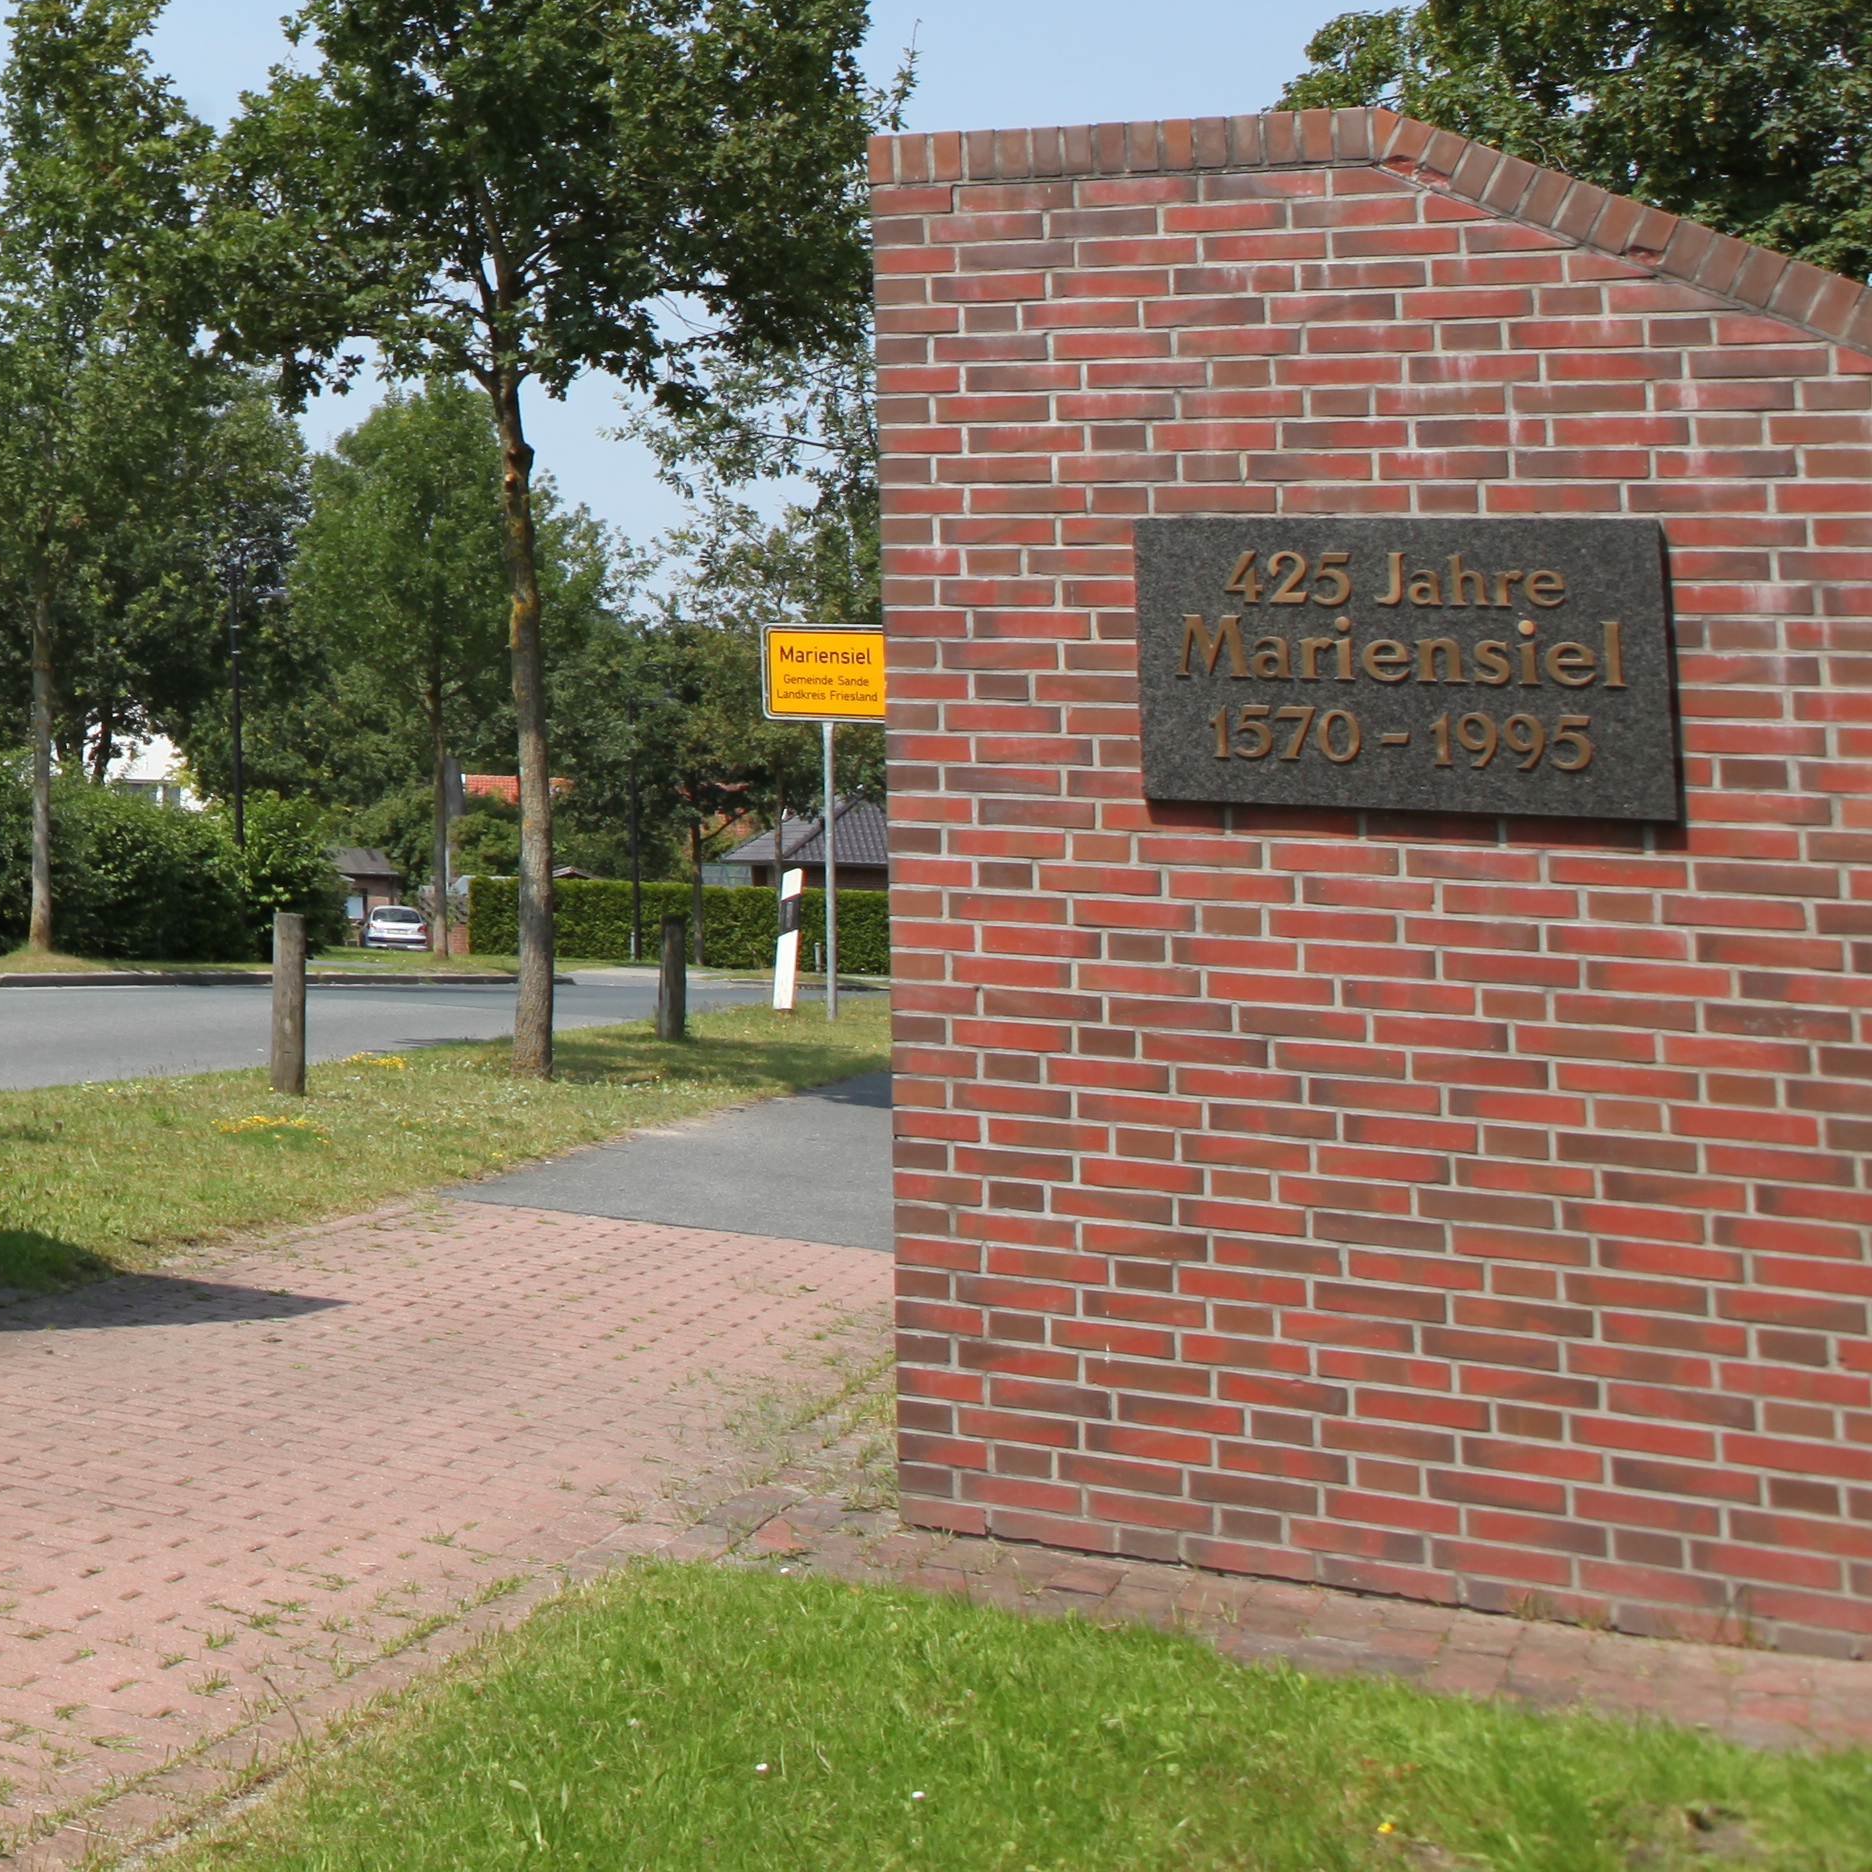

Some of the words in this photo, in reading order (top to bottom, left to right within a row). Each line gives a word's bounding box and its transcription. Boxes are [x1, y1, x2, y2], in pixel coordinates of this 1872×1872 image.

[1224, 550, 1352, 606] 425
[1373, 551, 1566, 608] Jahre
[779, 645, 872, 665] Mariensiel
[1176, 613, 1627, 688] Mariensiel
[777, 688, 826, 700] Landkreis
[830, 690, 878, 702] Friesland
[783, 674, 834, 685] Gemeinde
[837, 675, 869, 686] Sande
[1208, 704, 1361, 763] 1570
[1429, 711, 1594, 771] 1995
